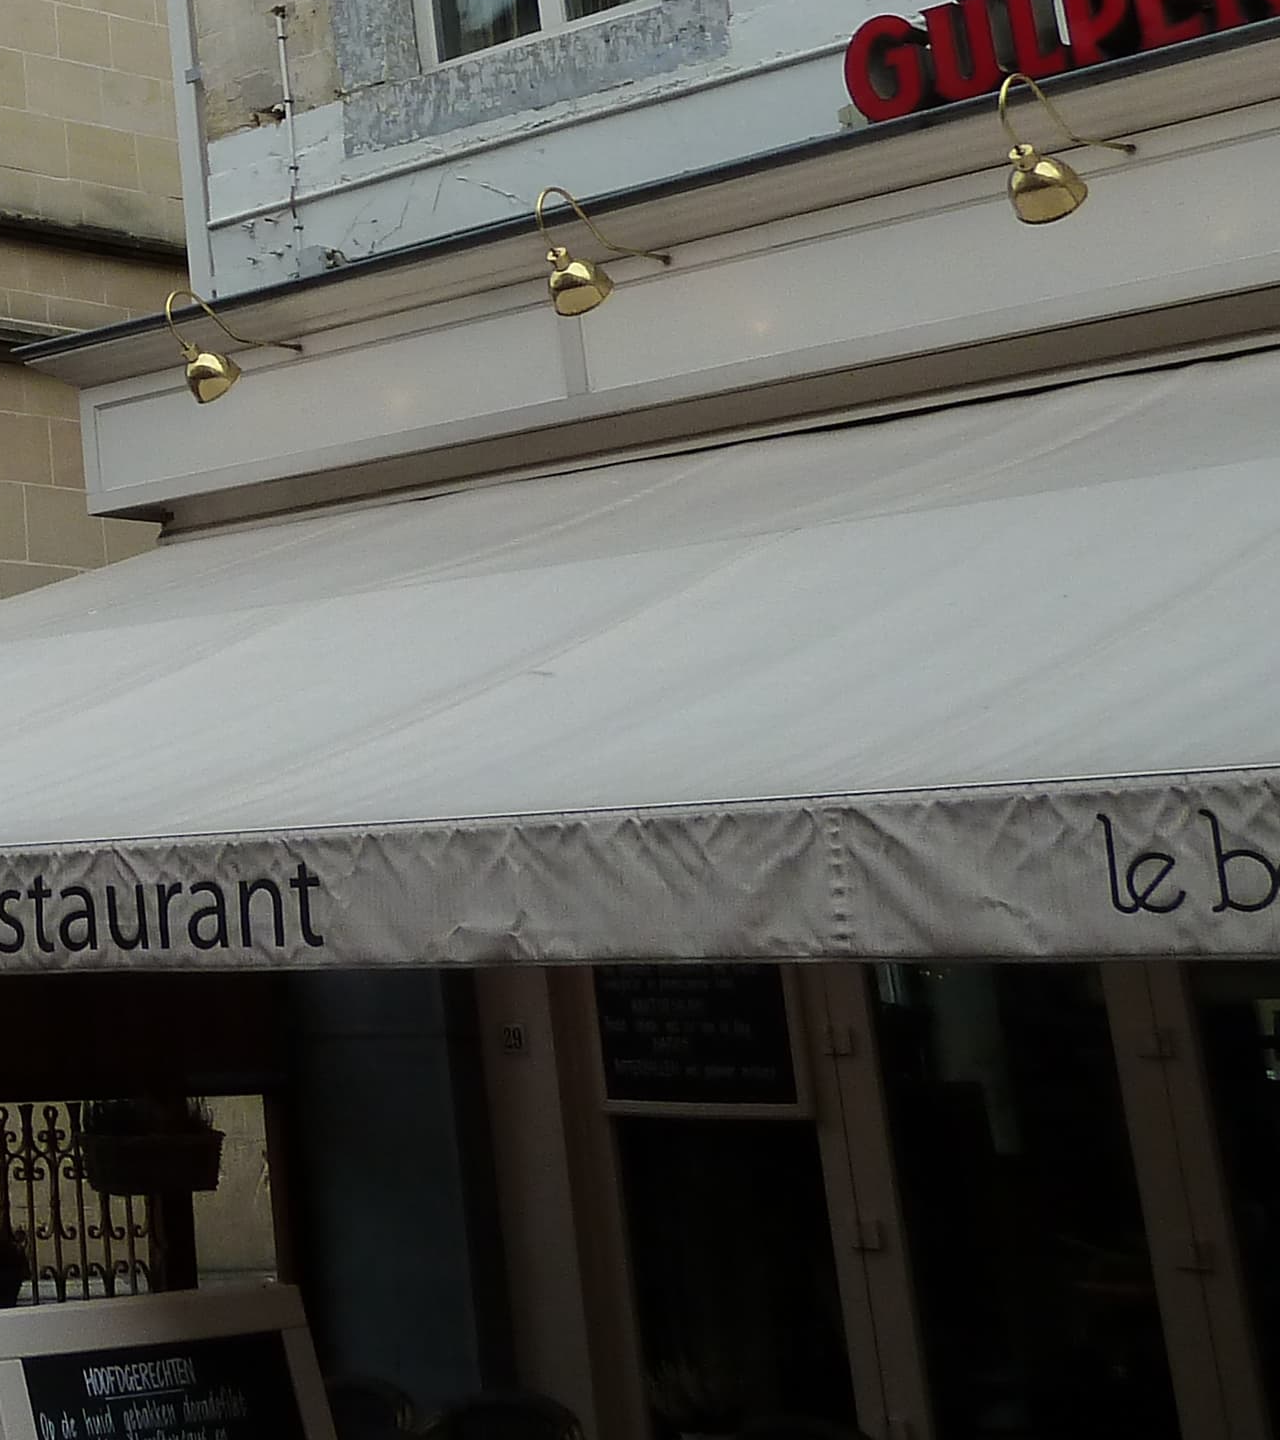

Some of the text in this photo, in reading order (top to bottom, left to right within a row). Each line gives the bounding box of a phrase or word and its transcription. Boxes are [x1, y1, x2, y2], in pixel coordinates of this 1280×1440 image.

[1096, 813, 1186, 914] le
[503, 1027, 522, 1049] 29
[82, 1358, 196, 1397] HOOFDGERECHTEN
[60, 1409, 78, 1439] de
[81, 1404, 116, 1437] huid
